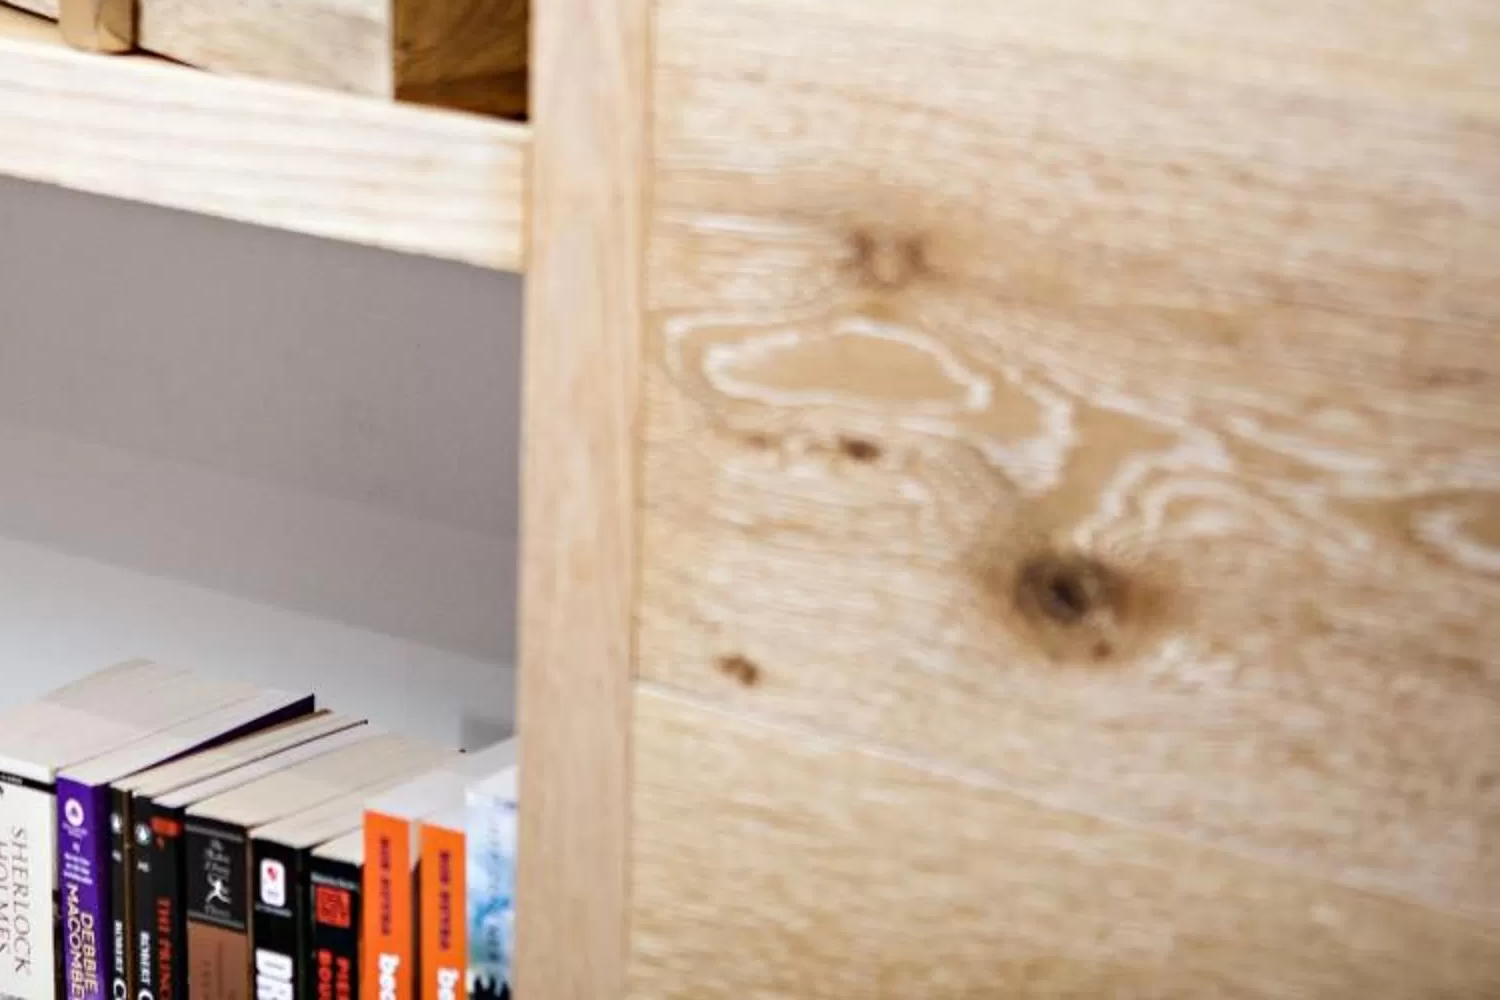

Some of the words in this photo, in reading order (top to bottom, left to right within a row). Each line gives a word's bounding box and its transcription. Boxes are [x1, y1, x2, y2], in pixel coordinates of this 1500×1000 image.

[10, 826, 32, 977] SHERLOCK
[156, 896, 172, 934] THE
[66, 884, 87, 1000] MACOMBE
[79, 912, 98, 995] DEBBIE
[114, 919, 125, 974] ROBERT
[139, 931, 152, 986] ROBERT
[159, 937, 174, 1000] PRINC
[255, 948, 293, 1000] DR
